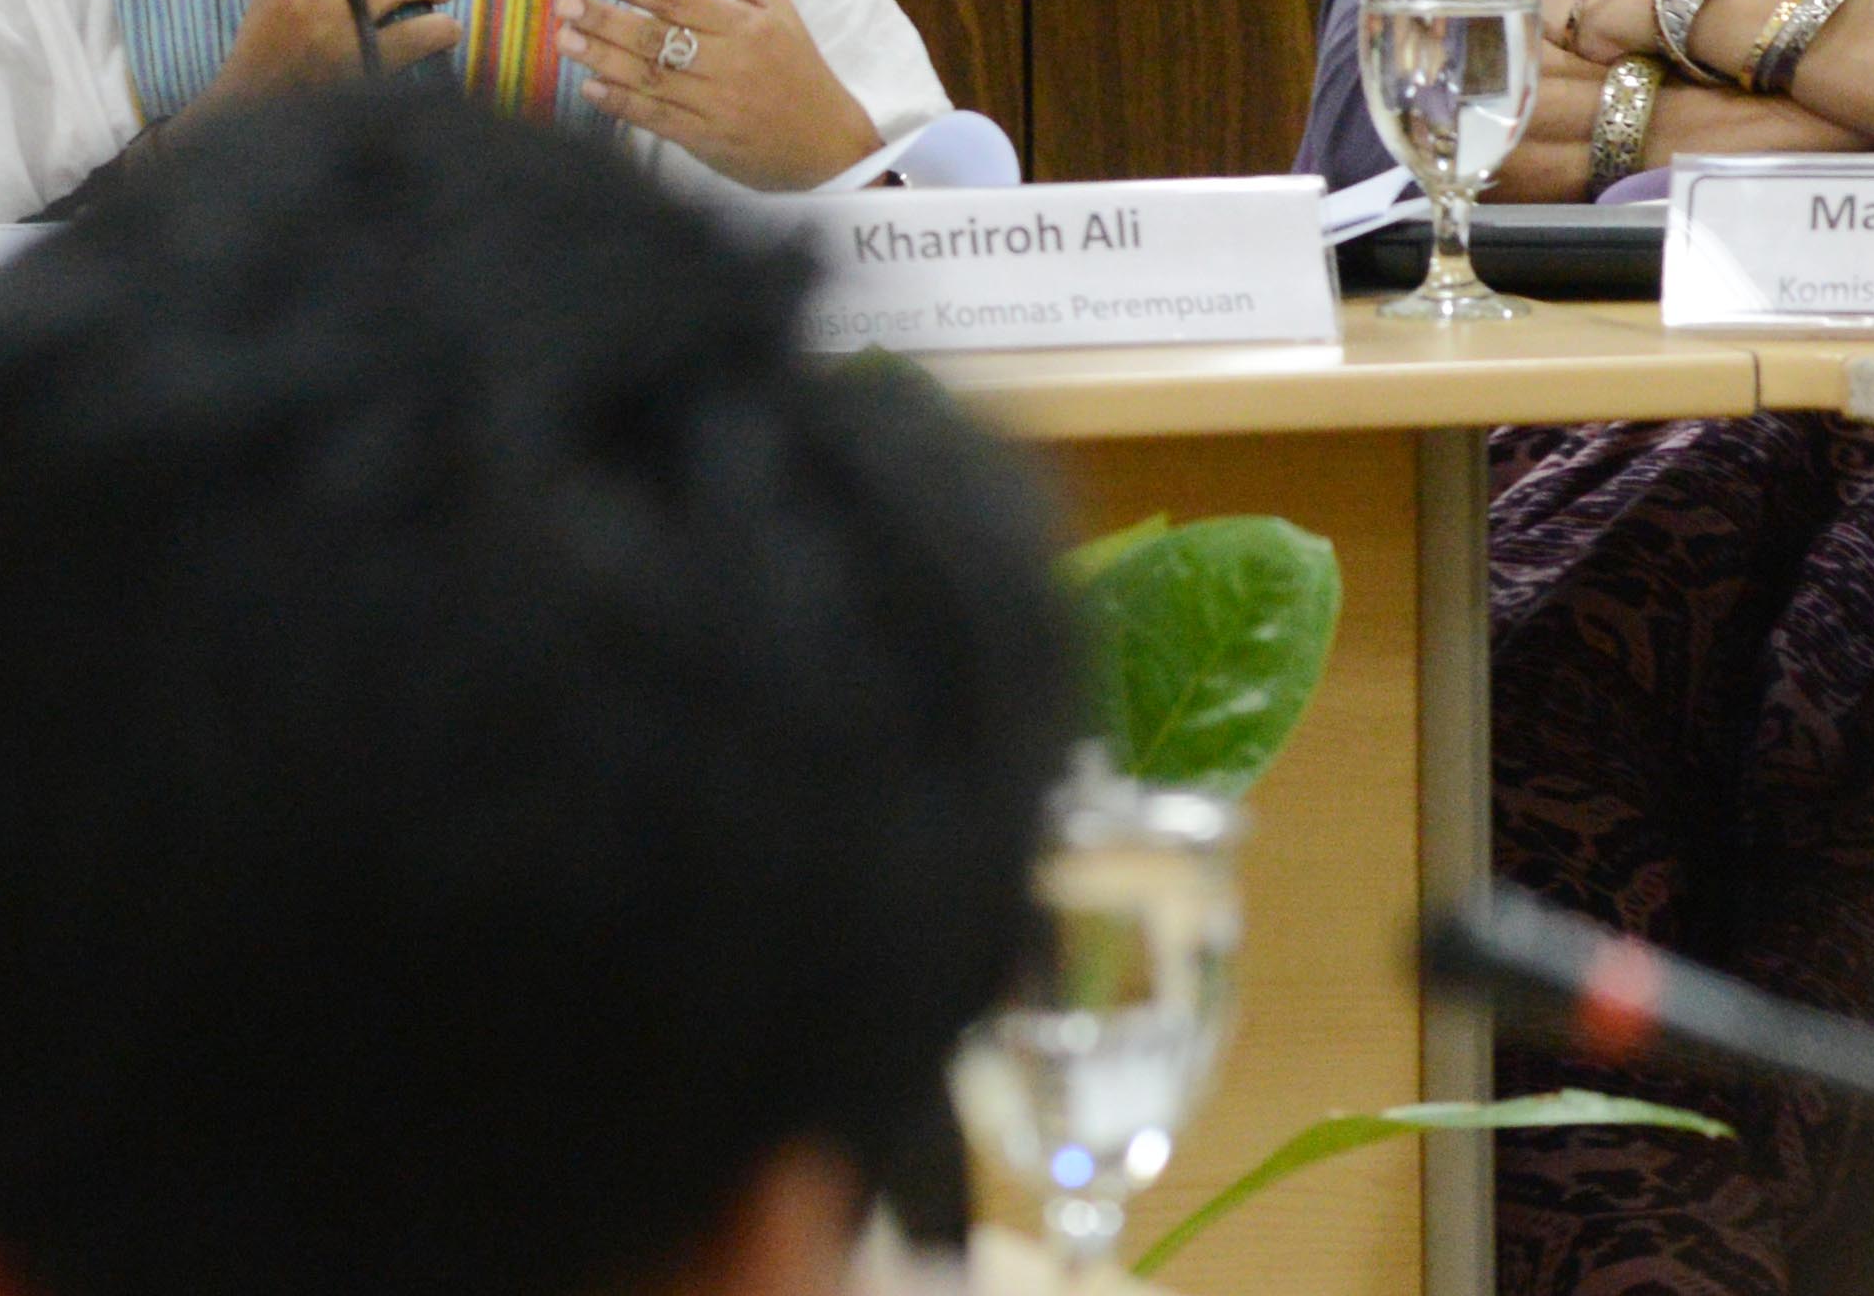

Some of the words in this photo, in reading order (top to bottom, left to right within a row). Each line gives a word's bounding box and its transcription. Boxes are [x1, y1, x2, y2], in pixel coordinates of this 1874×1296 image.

[854, 212, 1063, 264] Khariroh
[1080, 209, 1143, 252] Ali
[935, 298, 1063, 329] Komnas
[1071, 290, 1256, 325] Perempuan
